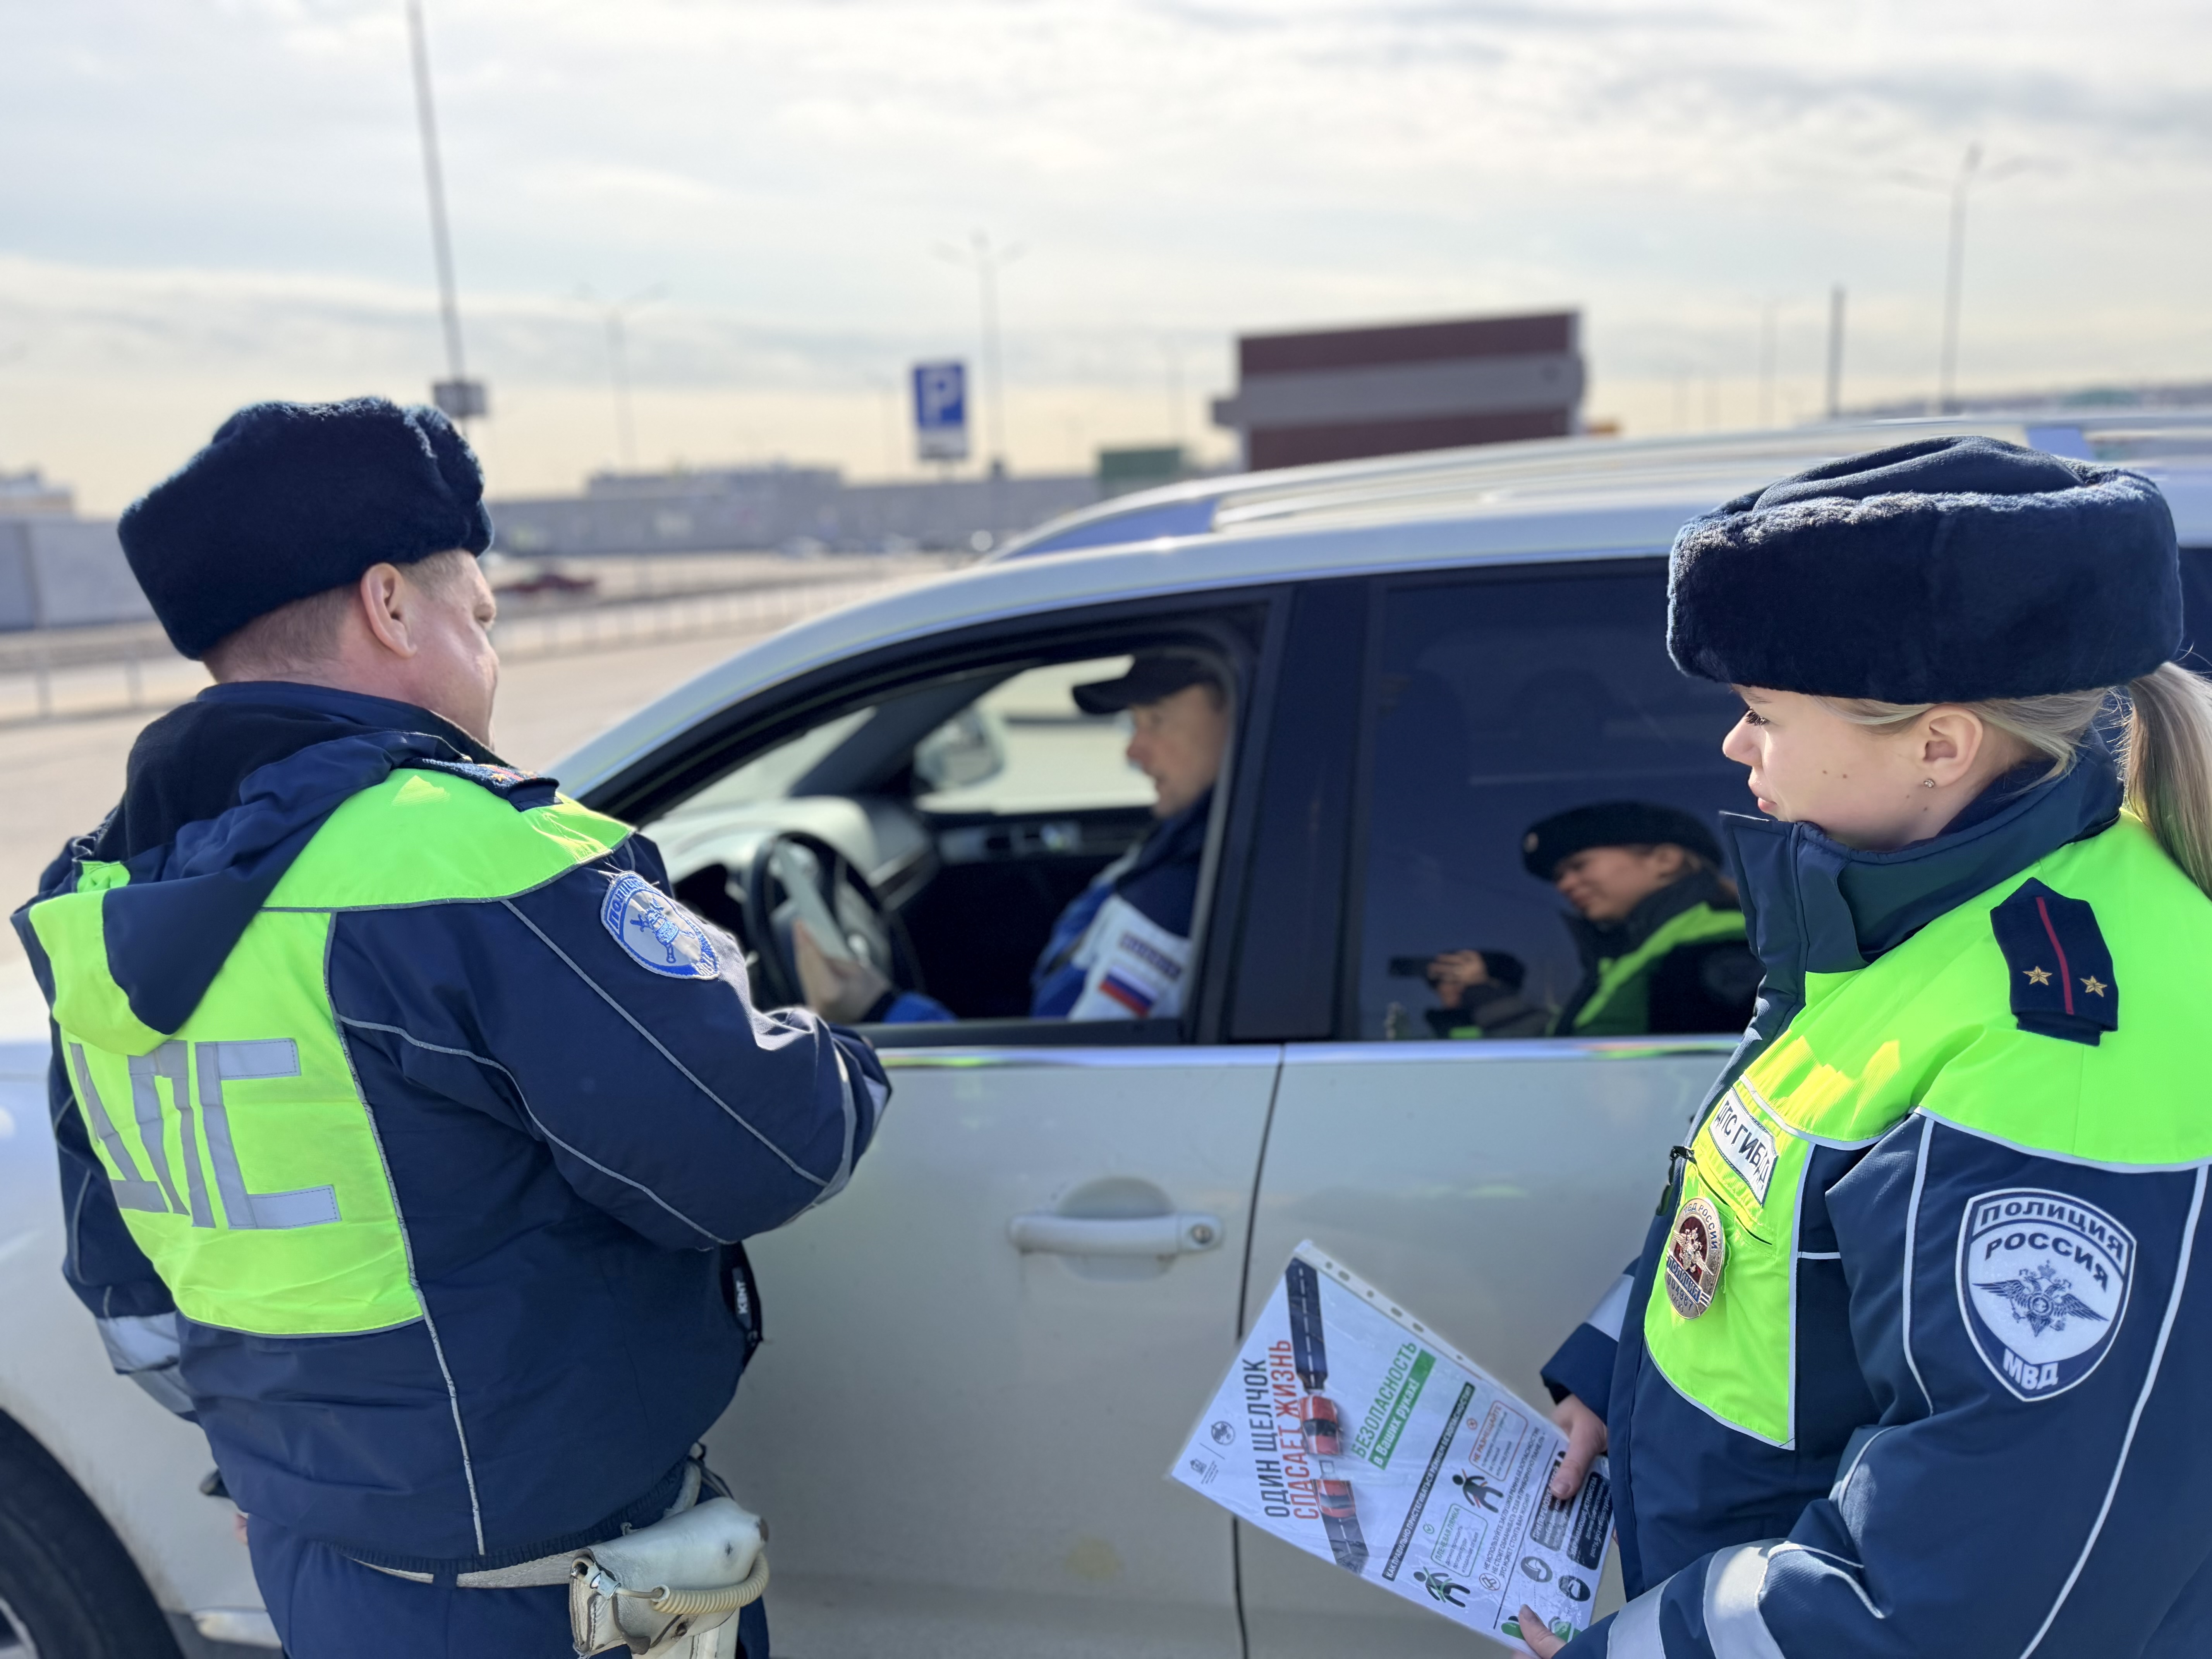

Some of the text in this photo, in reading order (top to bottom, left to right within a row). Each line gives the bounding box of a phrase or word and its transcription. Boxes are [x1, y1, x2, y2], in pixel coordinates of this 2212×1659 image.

[1714, 1100, 1770, 1191] ДПС ГИБДД
[1698, 1204, 1717, 1249] РОССИИ
[1980, 1201, 2128, 1263] ПОЛИЦИЯ
[1668, 1257, 1700, 1299] ПОЛИЦИЯ
[1985, 1233, 2109, 1293] РОССИЯ
[2003, 1348, 2059, 1390] МВД
[1350, 1340, 1417, 1458] БЕЗОПАСНОСТЬ
[1242, 1359, 1291, 1516] ОДИН ЩЕЛЧОК
[1267, 1340, 1319, 1518] СПАСАЕТ ЖИЗНЬ
[1373, 1377, 1420, 1466] в Ваших руках!
[1472, 1452, 1482, 1463] НЕ
[1531, 1435, 1545, 1460] ПАНЕЛЬ
[1508, 1476, 1520, 1496] РЕМНЯ
[1518, 1459, 1535, 1496] ПРИБОРНУЮ
[1386, 1563, 1396, 1578] КАК
[1391, 1528, 1411, 1565] ПРАВИЛЬНО
[1406, 1472, 1434, 1530] ПРИСТЕГИВАТЬСЯ
[1429, 1444, 1446, 1474] РЕМНЕМ
[1499, 1494, 1513, 1525] ЗАГЛУШКИ
[1512, 1499, 1520, 1513] СЕБЯ
[1536, 1488, 1553, 1525] ПЕРЕВОЗКЕ
[1570, 1476, 1597, 1556] УДЕРЖИВАЮЩИЕ УСТРОЙСТВА
[1434, 1506, 1460, 1561] ПЛЕЧЕВАЯ ЛЯМКА
[1486, 1523, 1503, 1563] ИСПОЛЬЗУЙТЕ
[1499, 1513, 1516, 1549] ОБМАНЫВАТЬ
[1502, 1547, 1513, 1567] МОЖЕТ
[1509, 1526, 1520, 1548] СТОИТЬ
[1532, 1524, 1541, 1539] ПРИ
[1542, 1509, 1559, 1544] необходимо
[1483, 1561, 1490, 1570] НЕ
[1494, 1548, 1504, 1566] СТОИТ
[1590, 1540, 1599, 1557] росту,
[1491, 1565, 1498, 1574] НЕ
